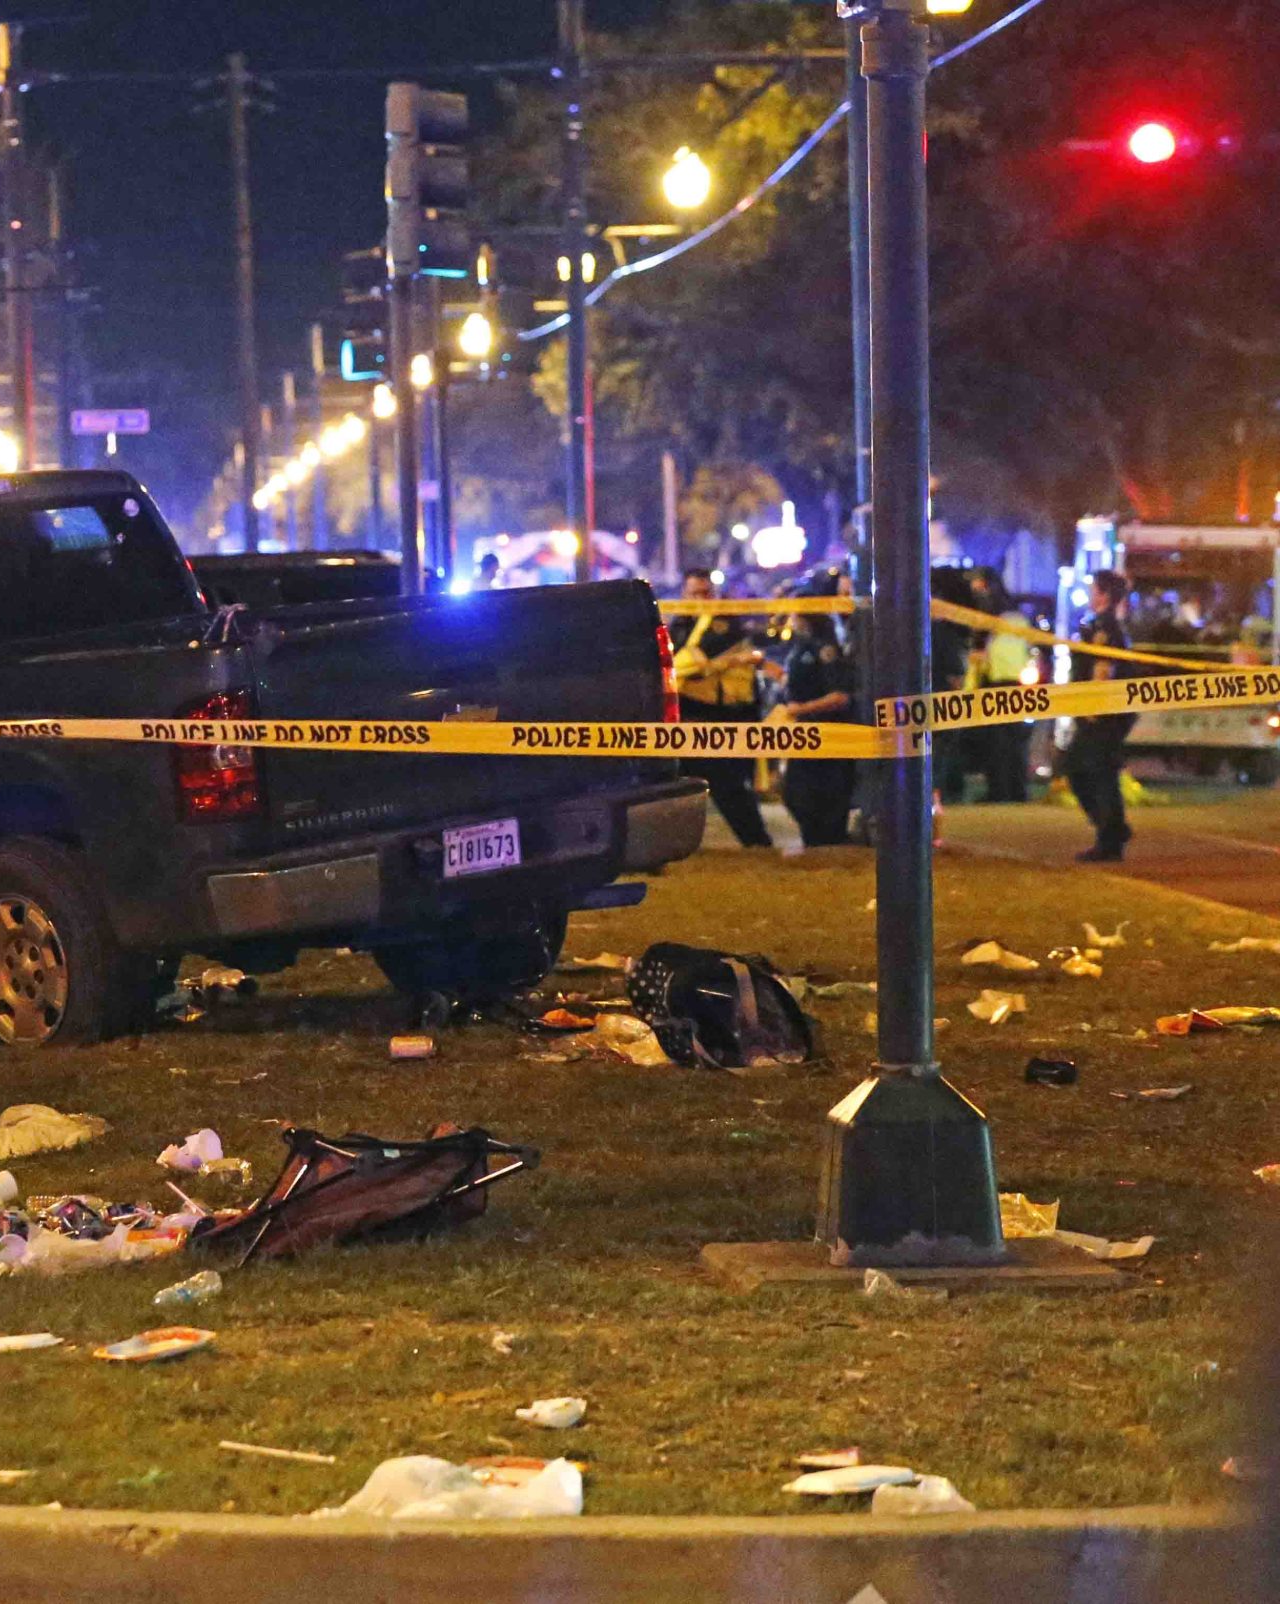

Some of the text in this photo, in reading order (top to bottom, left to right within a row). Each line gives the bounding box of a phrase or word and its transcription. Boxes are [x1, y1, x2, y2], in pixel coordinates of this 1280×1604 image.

[1126, 678, 1198, 705] POLICE
[1203, 675, 1248, 699] LINE
[896, 699, 927, 726] DO
[934, 694, 975, 723] NOT
[981, 688, 1051, 717] CROSS
[142, 723, 431, 744] POLICE LINE DO NOT CROSS
[512, 726, 822, 750] POLICE LINE DO NOT CROSS
[448, 833, 515, 867] C181673
